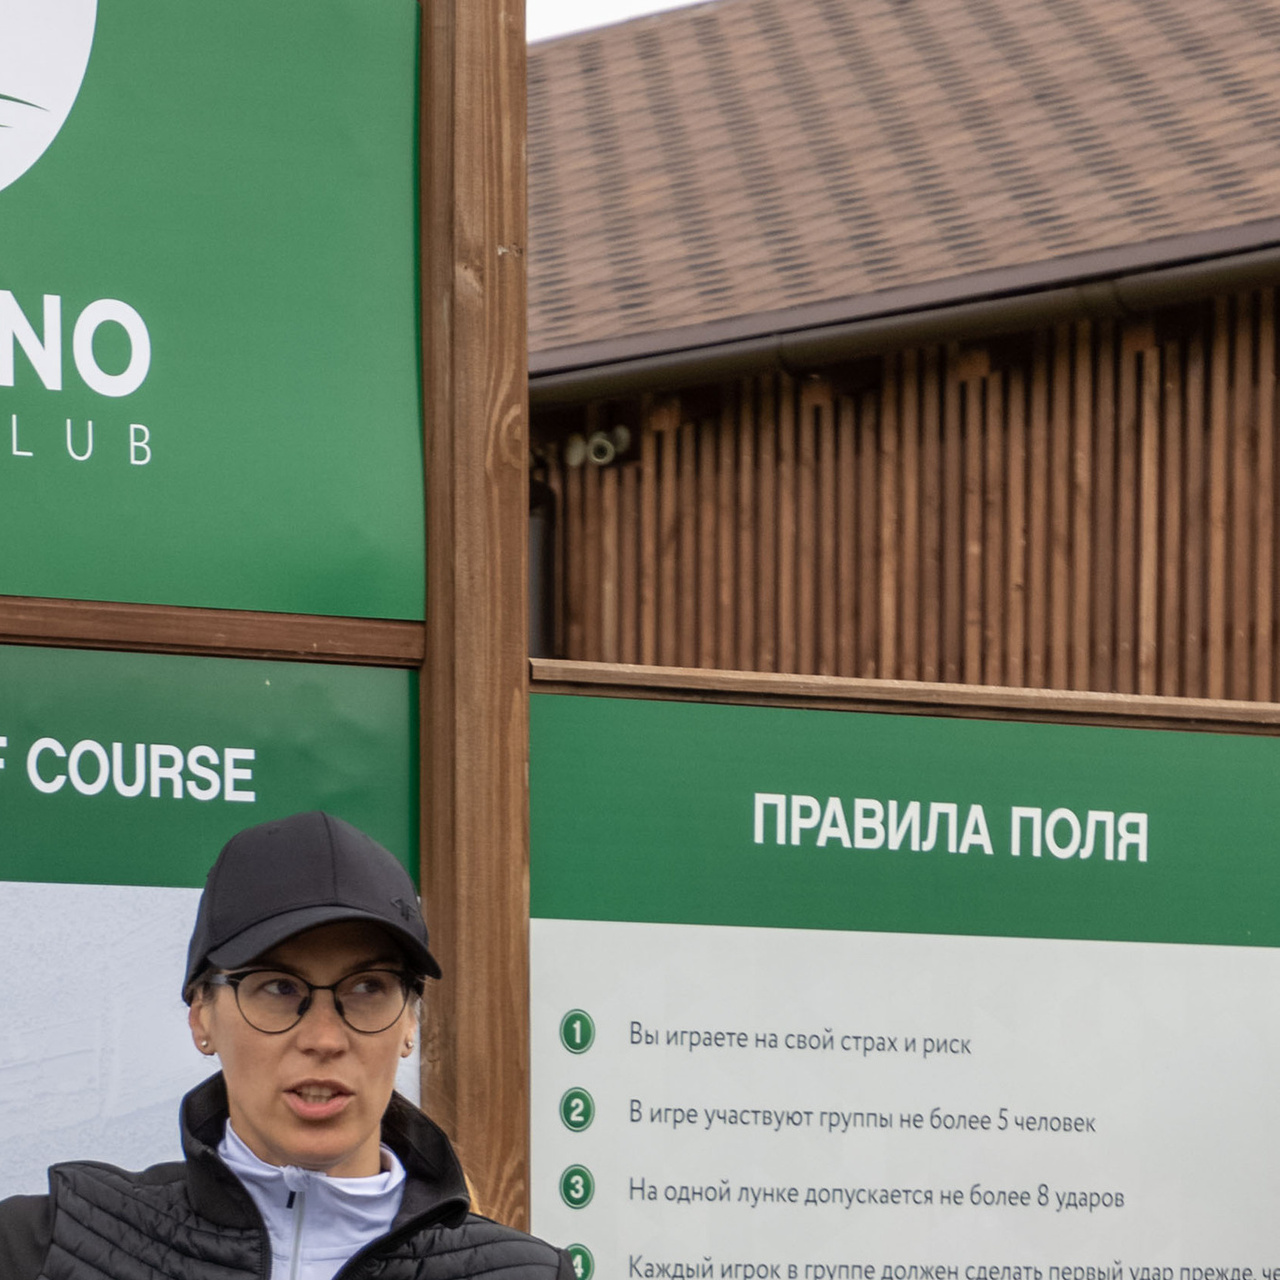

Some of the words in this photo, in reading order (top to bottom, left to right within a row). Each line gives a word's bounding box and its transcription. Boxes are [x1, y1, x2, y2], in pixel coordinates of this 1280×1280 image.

[26, 737, 256, 802] COURSE
[753, 793, 993, 855] ПРАВИЛА
[1010, 807, 1148, 862] ПОЛЯ
[572, 1020, 581, 1043] 1
[629, 1019, 659, 1045] Вы
[665, 1028, 749, 1052] играете
[754, 1031, 779, 1048] на
[784, 1026, 835, 1050] свой
[840, 1033, 899, 1057] страх
[904, 1035, 917, 1052] и
[922, 1036, 972, 1059] риск
[570, 1098, 584, 1122] 2
[629, 1097, 643, 1123] В
[649, 1106, 699, 1130] игре
[703, 1107, 815, 1132] участвуют
[819, 1109, 893, 1133] группы
[899, 1111, 925, 1129] не
[929, 1105, 993, 1130] более
[996, 1106, 1009, 1131] 5
[1013, 1114, 1097, 1132] человек
[570, 1175, 584, 1199] 3
[629, 1175, 658, 1201] На
[663, 1177, 732, 1204] одной
[736, 1185, 800, 1208] лунке
[803, 1186, 934, 1210] допускается
[939, 1188, 965, 1206] не
[969, 1181, 1032, 1207] более
[1036, 1181, 1050, 1207] 8
[1054, 1189, 1125, 1213] ударов
[787, 1262, 799, 1280] в
